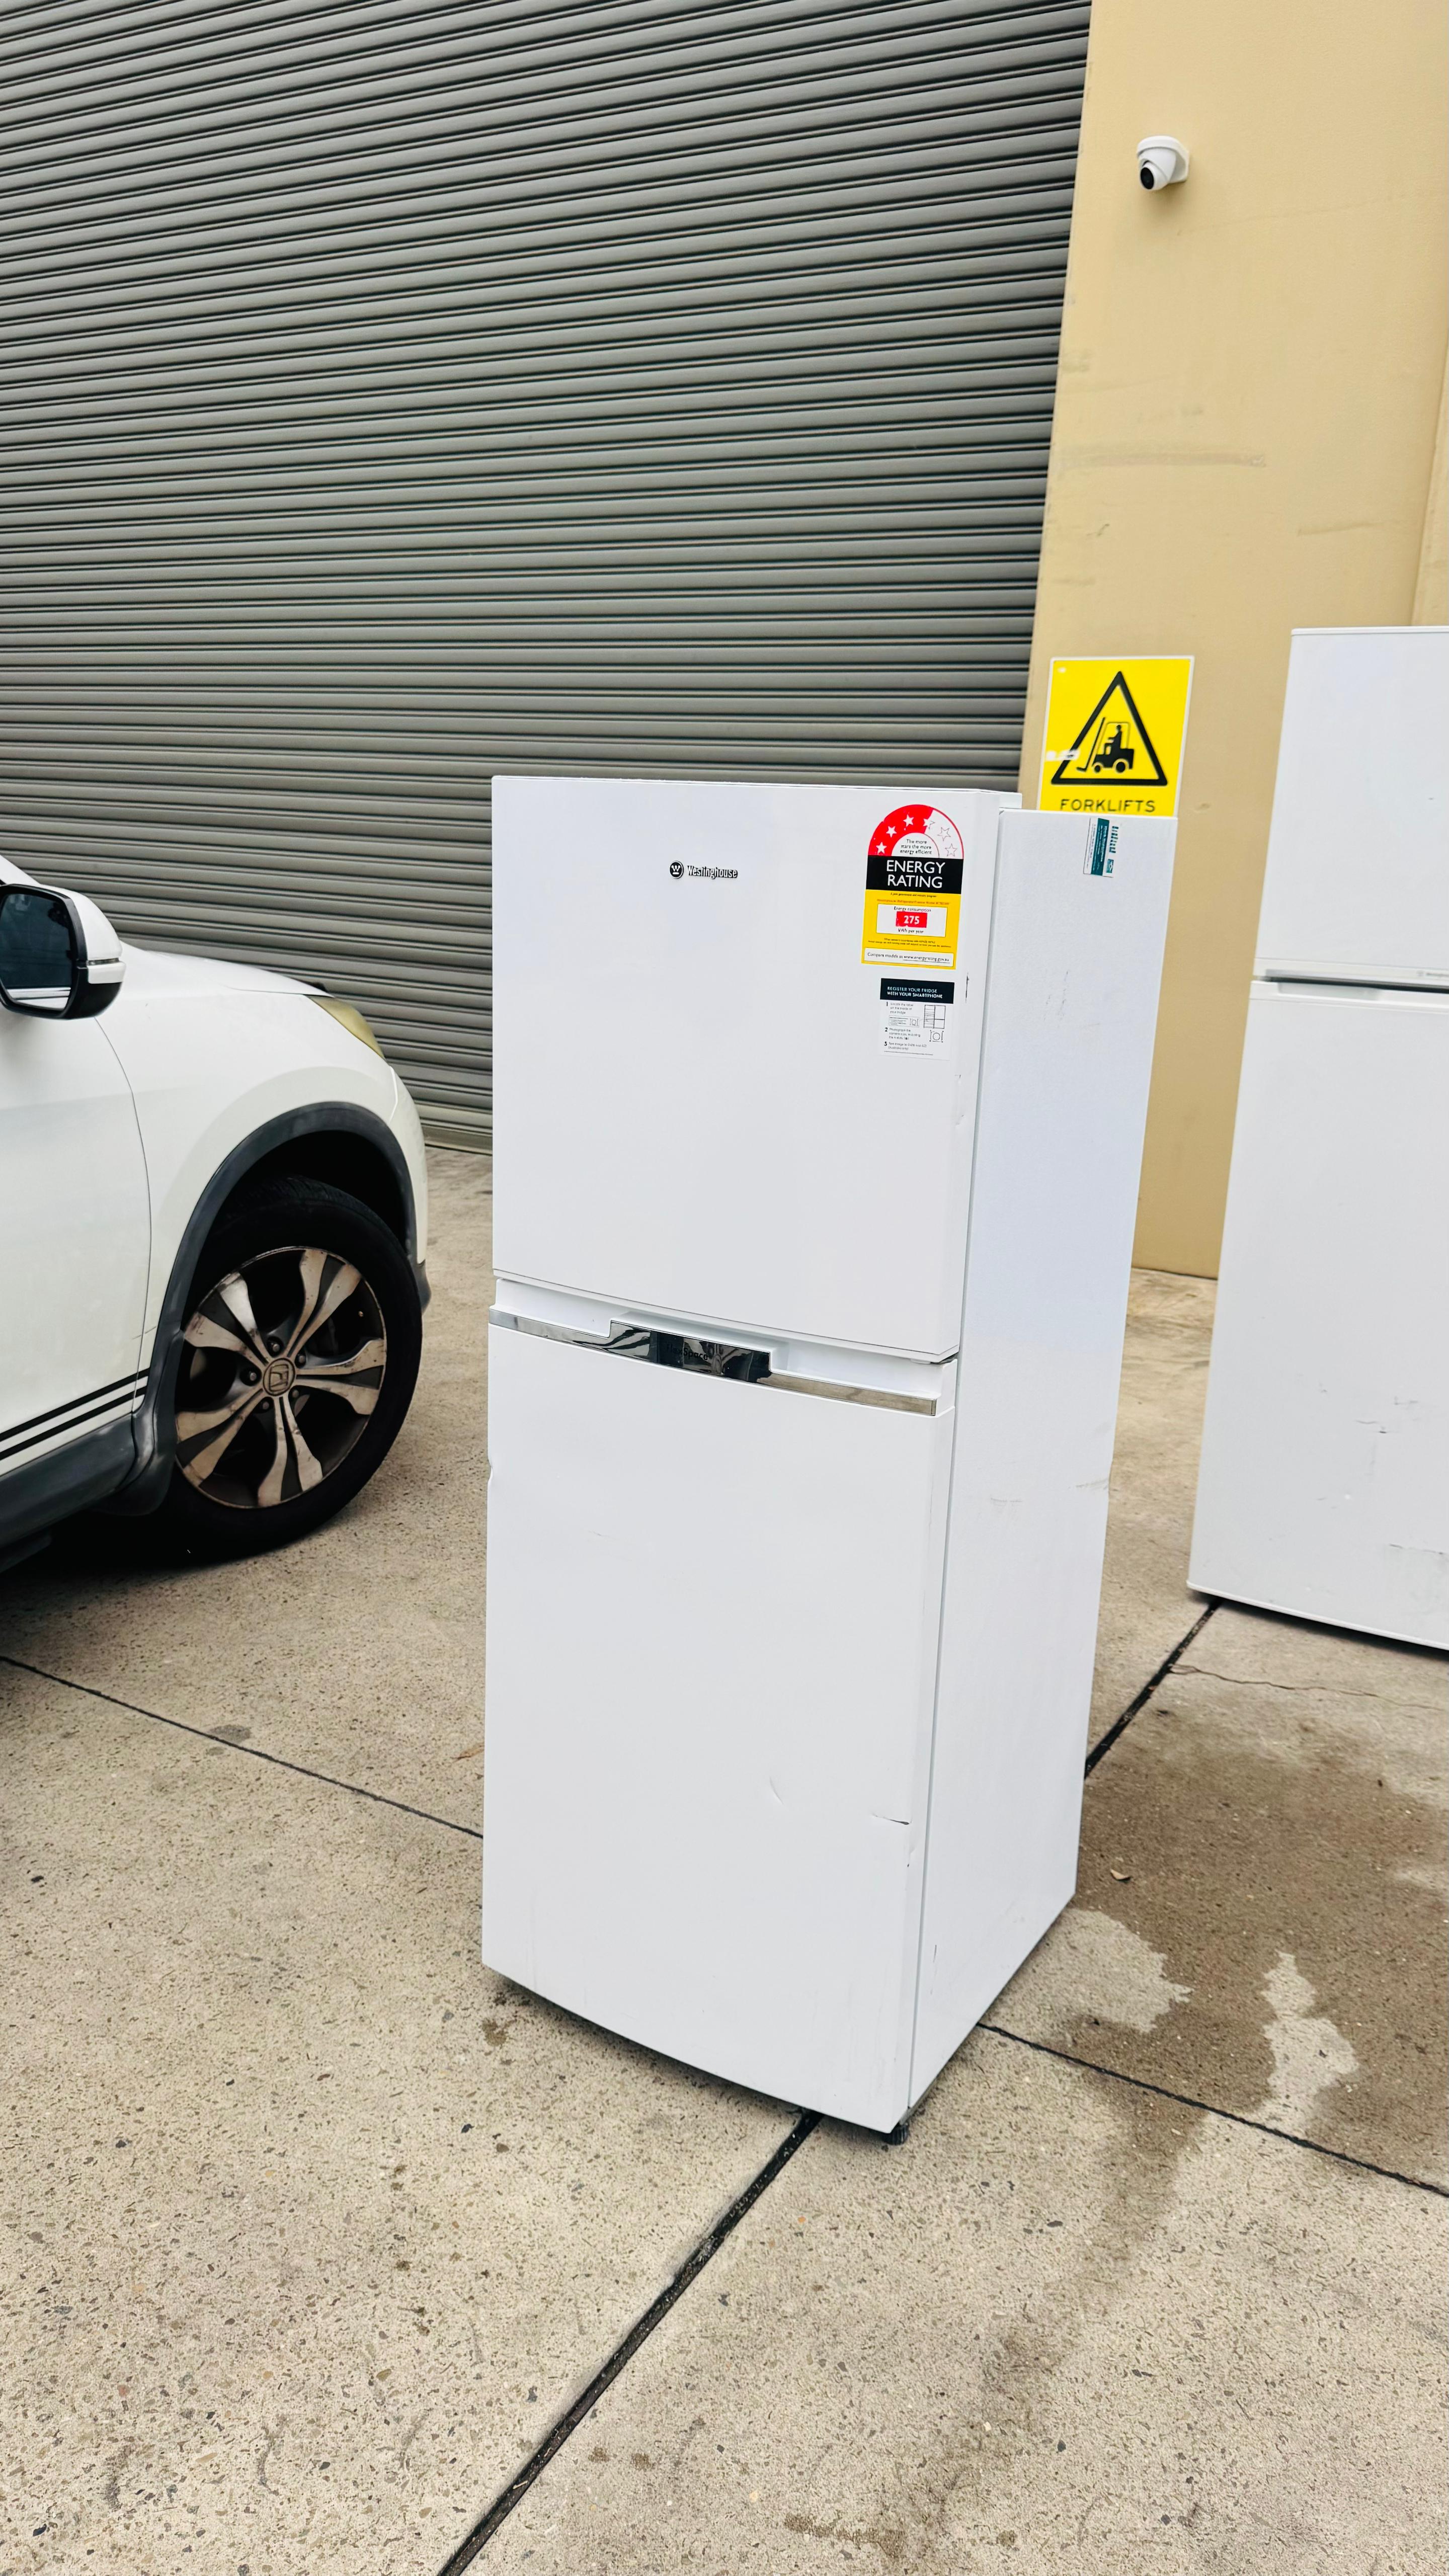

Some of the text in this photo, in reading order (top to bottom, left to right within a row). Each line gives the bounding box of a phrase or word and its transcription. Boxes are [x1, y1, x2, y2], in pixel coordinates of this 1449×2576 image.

[1060, 798, 1156, 813] FORKLIFTS
[687, 865, 738, 879] Westinghouse
[887, 860, 946, 874] ENERGY
[887, 874, 943, 889] RATING
[904, 915, 920, 925] 275
